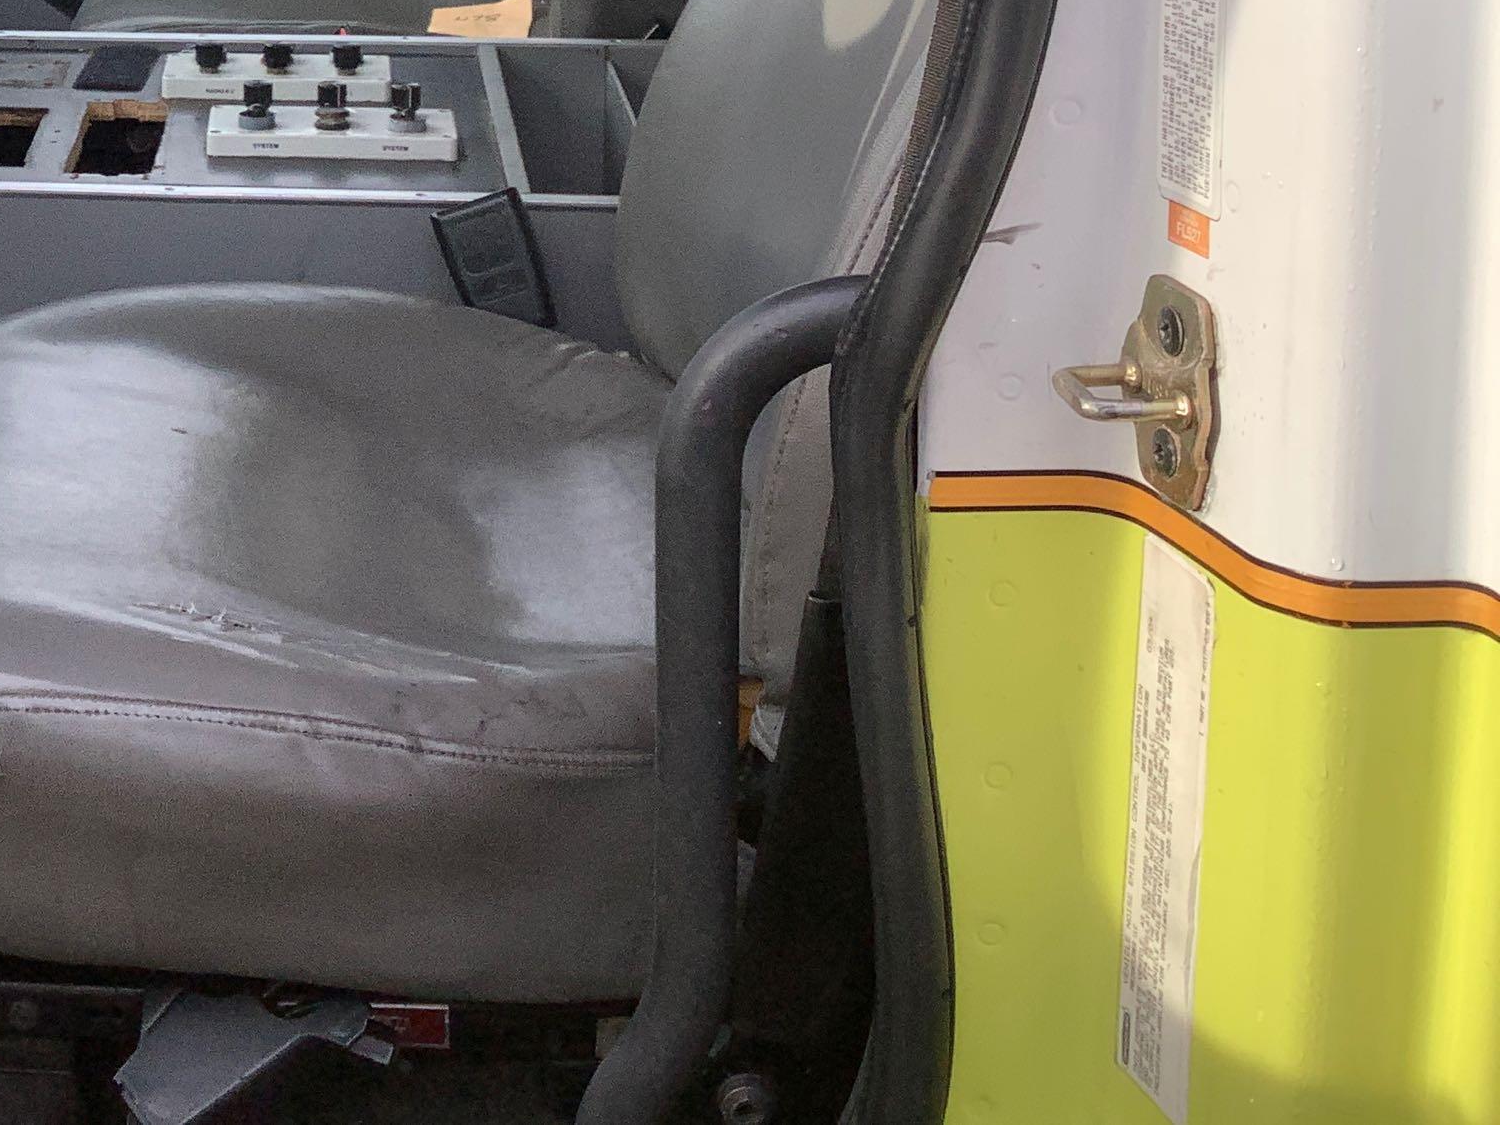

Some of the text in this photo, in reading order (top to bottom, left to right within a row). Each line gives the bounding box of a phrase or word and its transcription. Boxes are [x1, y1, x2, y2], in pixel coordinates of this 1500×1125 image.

[1162, 14, 1170, 68] CONFORMS
[1189, 8, 1197, 70] COMPLETED
[1160, 74, 1169, 147] CHASSIS-CAB
[1181, 100, 1187, 115] TO
[1178, 120, 1187, 187] CONFORMITY
[1134, 682, 1143, 763] INFORMATION
[1131, 772, 1139, 822] CONTROL
[1127, 827, 1136, 887] EMISSION
[1122, 936, 1130, 984] VEHICLE
